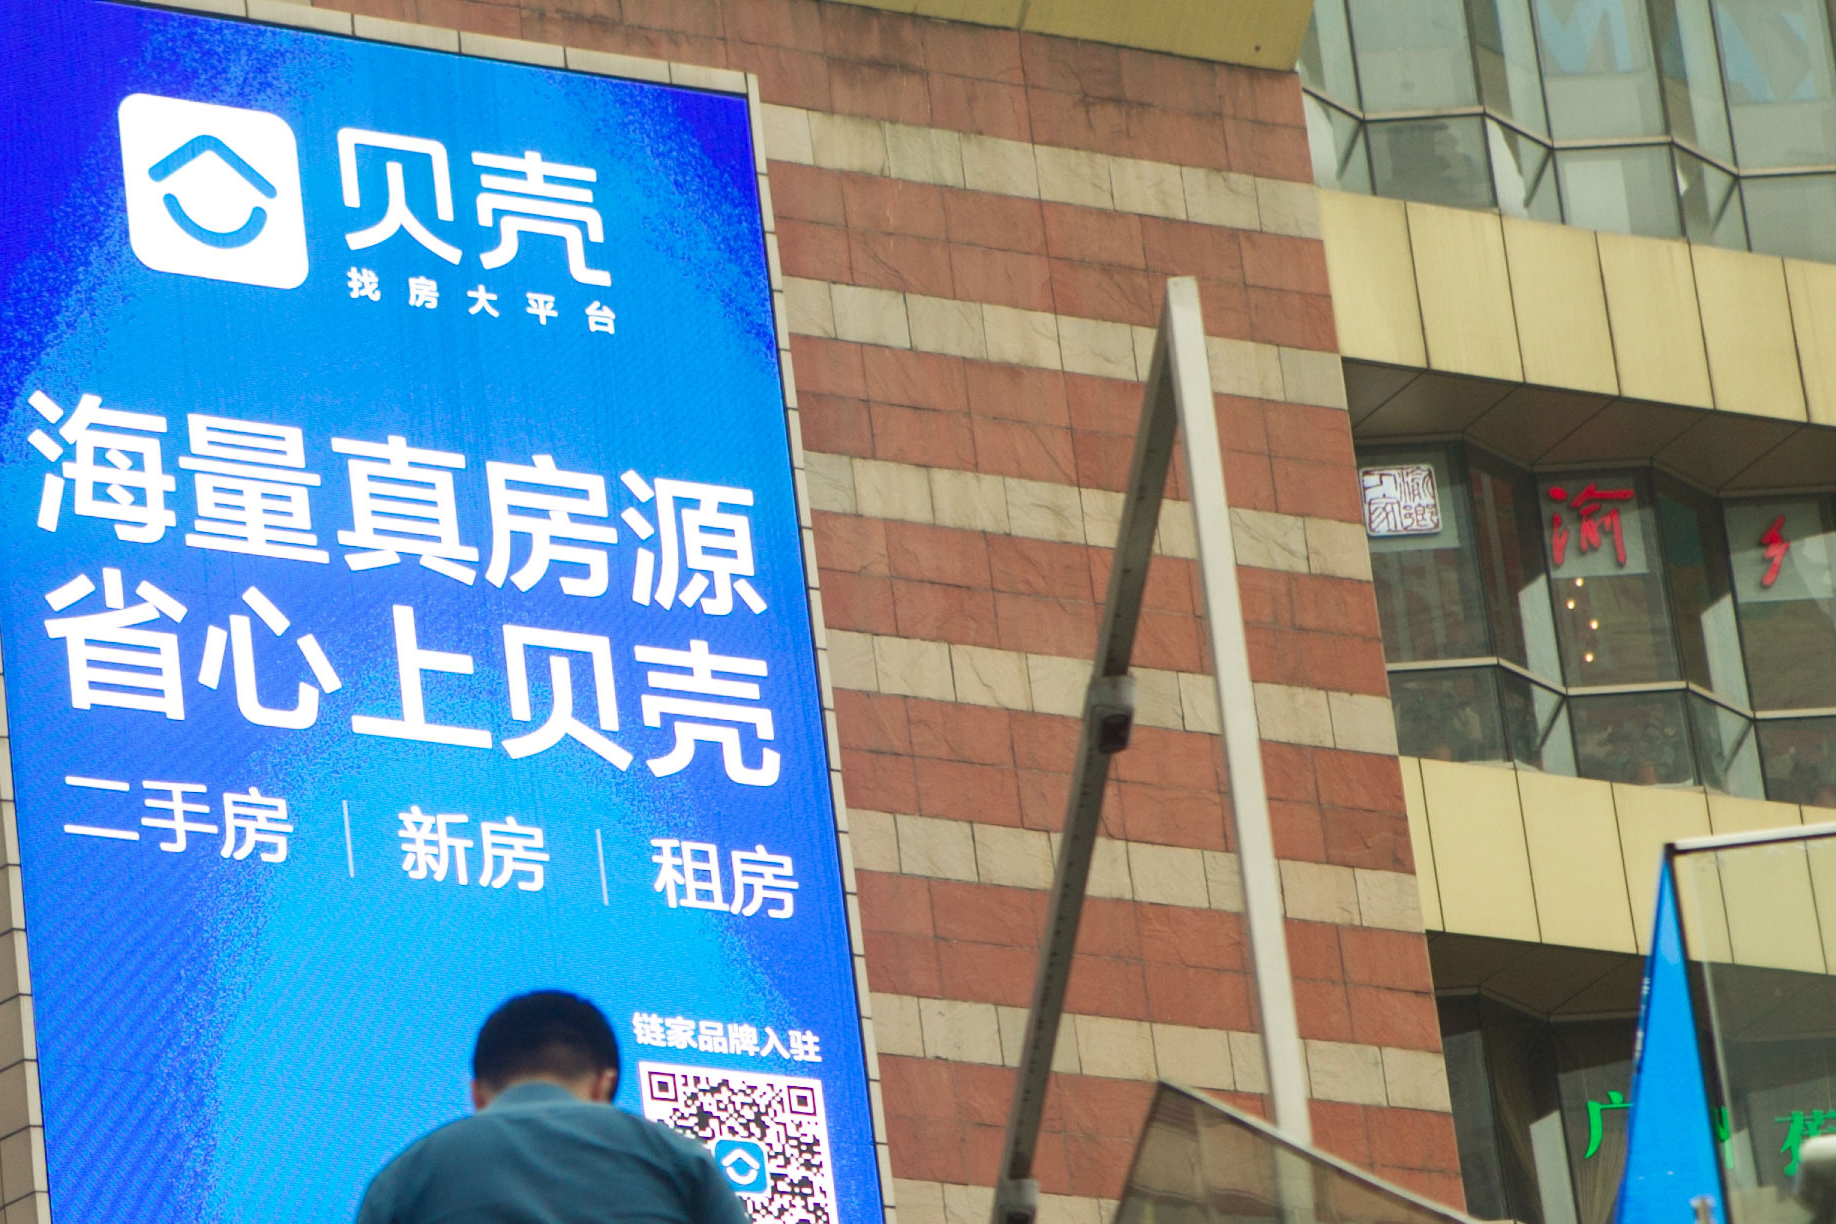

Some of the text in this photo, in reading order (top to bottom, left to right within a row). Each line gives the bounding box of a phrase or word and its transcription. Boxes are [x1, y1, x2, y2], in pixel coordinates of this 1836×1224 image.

[336, 127, 611, 287] 贝壳
[346, 266, 618, 335] 找房大平台
[27, 389, 767, 615] 海量真房源
[43, 567, 781, 787] 省心上贝壳
[64, 775, 800, 920] 二手房 新房 租房
[632, 1011, 822, 1063] 链家品牌入驻
